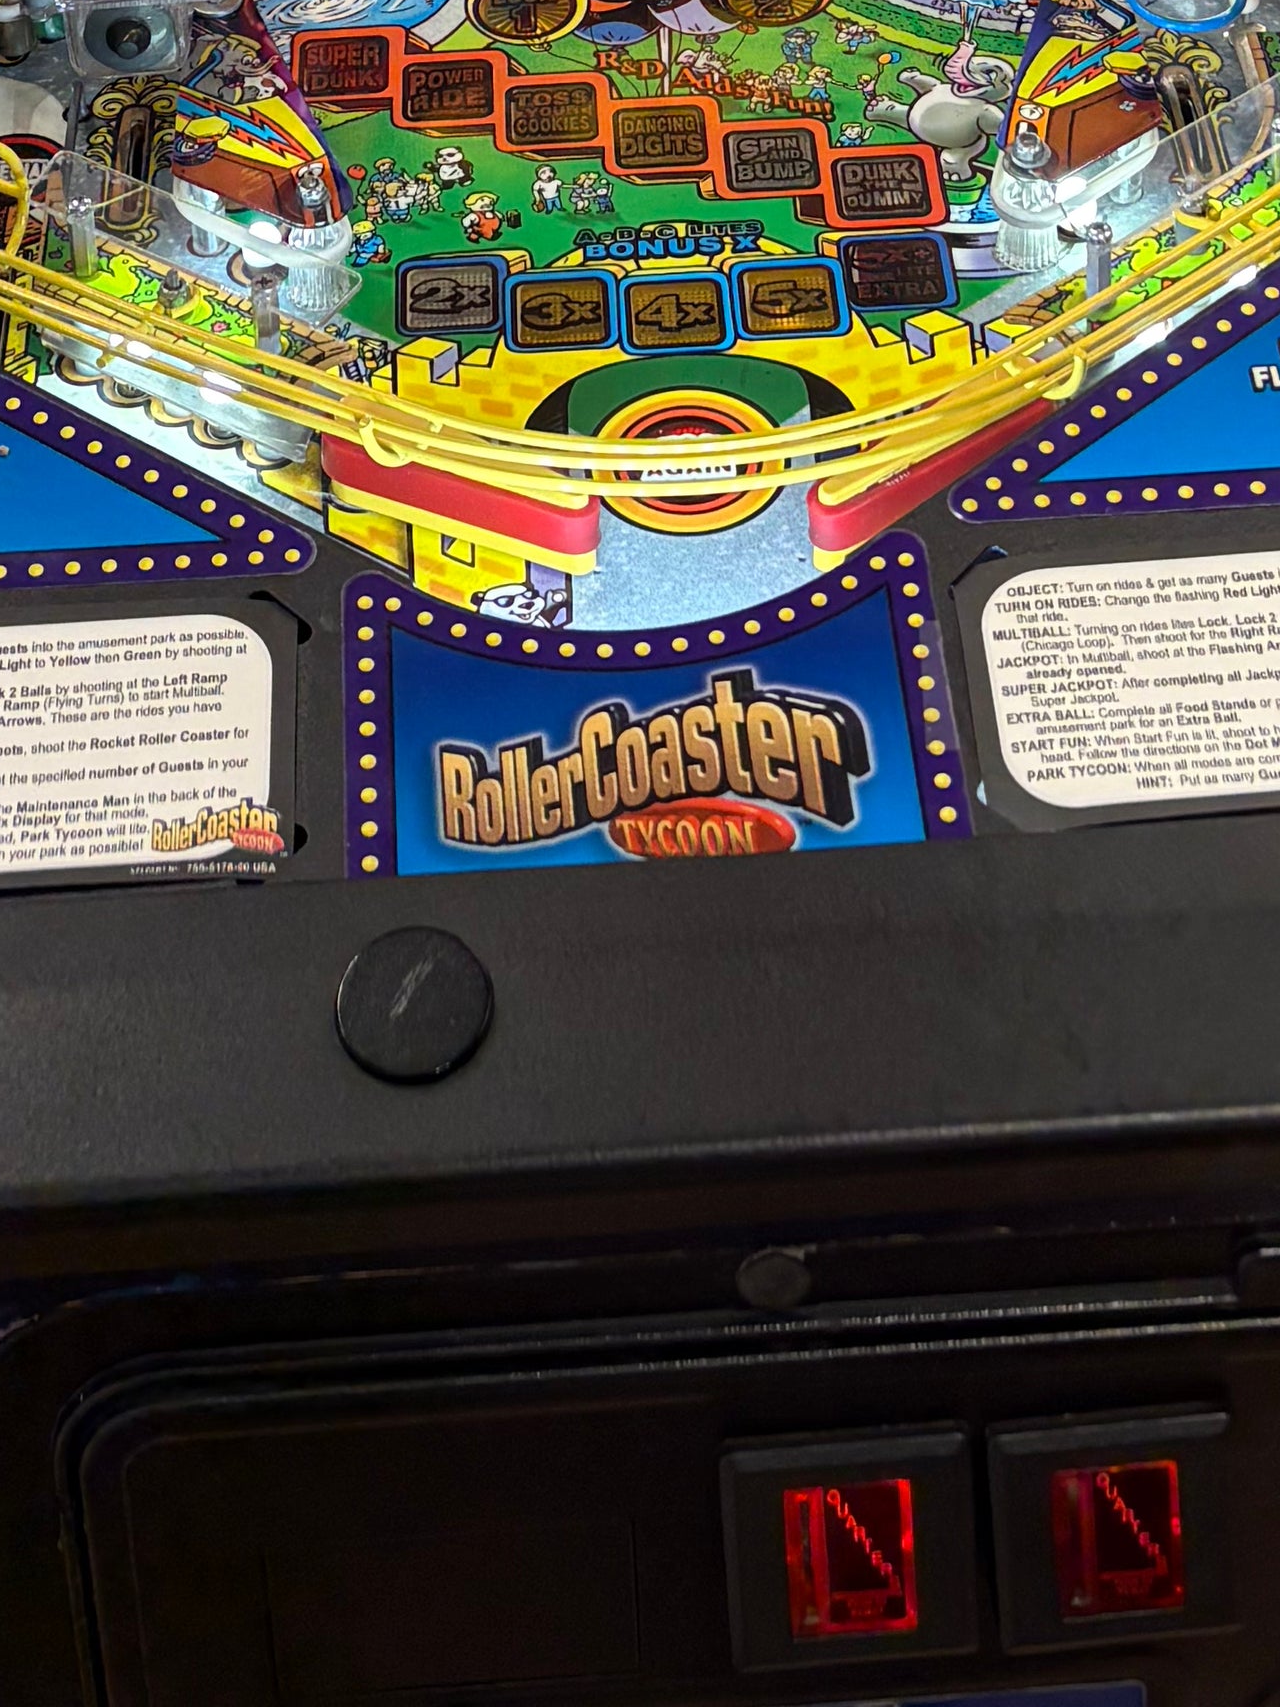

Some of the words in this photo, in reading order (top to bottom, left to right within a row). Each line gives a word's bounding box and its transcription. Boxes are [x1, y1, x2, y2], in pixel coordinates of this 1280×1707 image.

[512, 1, 538, 35] 1
[306, 43, 381, 69] SUPER
[596, 50, 666, 78] R&D
[308, 66, 380, 90] DUNK
[409, 64, 484, 88] POWER
[413, 87, 488, 114] RIDE
[517, 88, 589, 109] TOSS
[673, 65, 750, 100] Adds
[772, 89, 835, 122] Fun!
[517, 114, 593, 136] COOKIES
[623, 115, 697, 135] DANCING
[621, 135, 704, 156] DIGITS
[738, 136, 799, 161] SPIN
[770, 148, 801, 161] AND
[736, 159, 813, 183] BUMP
[845, 160, 915, 184] DUNK
[868, 178, 903, 191] THE
[846, 187, 923, 208] DUMMY
[575, 223, 677, 243] A-B-C
[687, 221, 762, 237] LITES
[584, 235, 723, 260] BONUS
[732, 234, 759, 252] X
[1007, 583, 1063, 598] OBJECT:
[1067, 581, 1093, 593] Turn
[1097, 582, 1111, 592] on
[1114, 579, 1142, 590] rides
[1146, 577, 1154, 589] &
[1158, 577, 1176, 590] get
[1179, 577, 1192, 586] as
[1197, 575, 1227, 586] many
[1232, 570, 1274, 583] Guests
[32, 641, 53, 653] into
[57, 640, 74, 651] the
[79, 634, 147, 650] amusement
[151, 633, 175, 646] park
[180, 633, 193, 644] as
[197, 629, 247, 644] possible.
[441, 679, 842, 843] RollerCoaster
[152, 798, 278, 850] RollerCoaster
[232, 832, 276, 853] TYCOON
[616, 815, 755, 858] TYCOON
[1096, 1470, 1161, 1558] QUARTER
[826, 1488, 893, 1577] QUARTER
